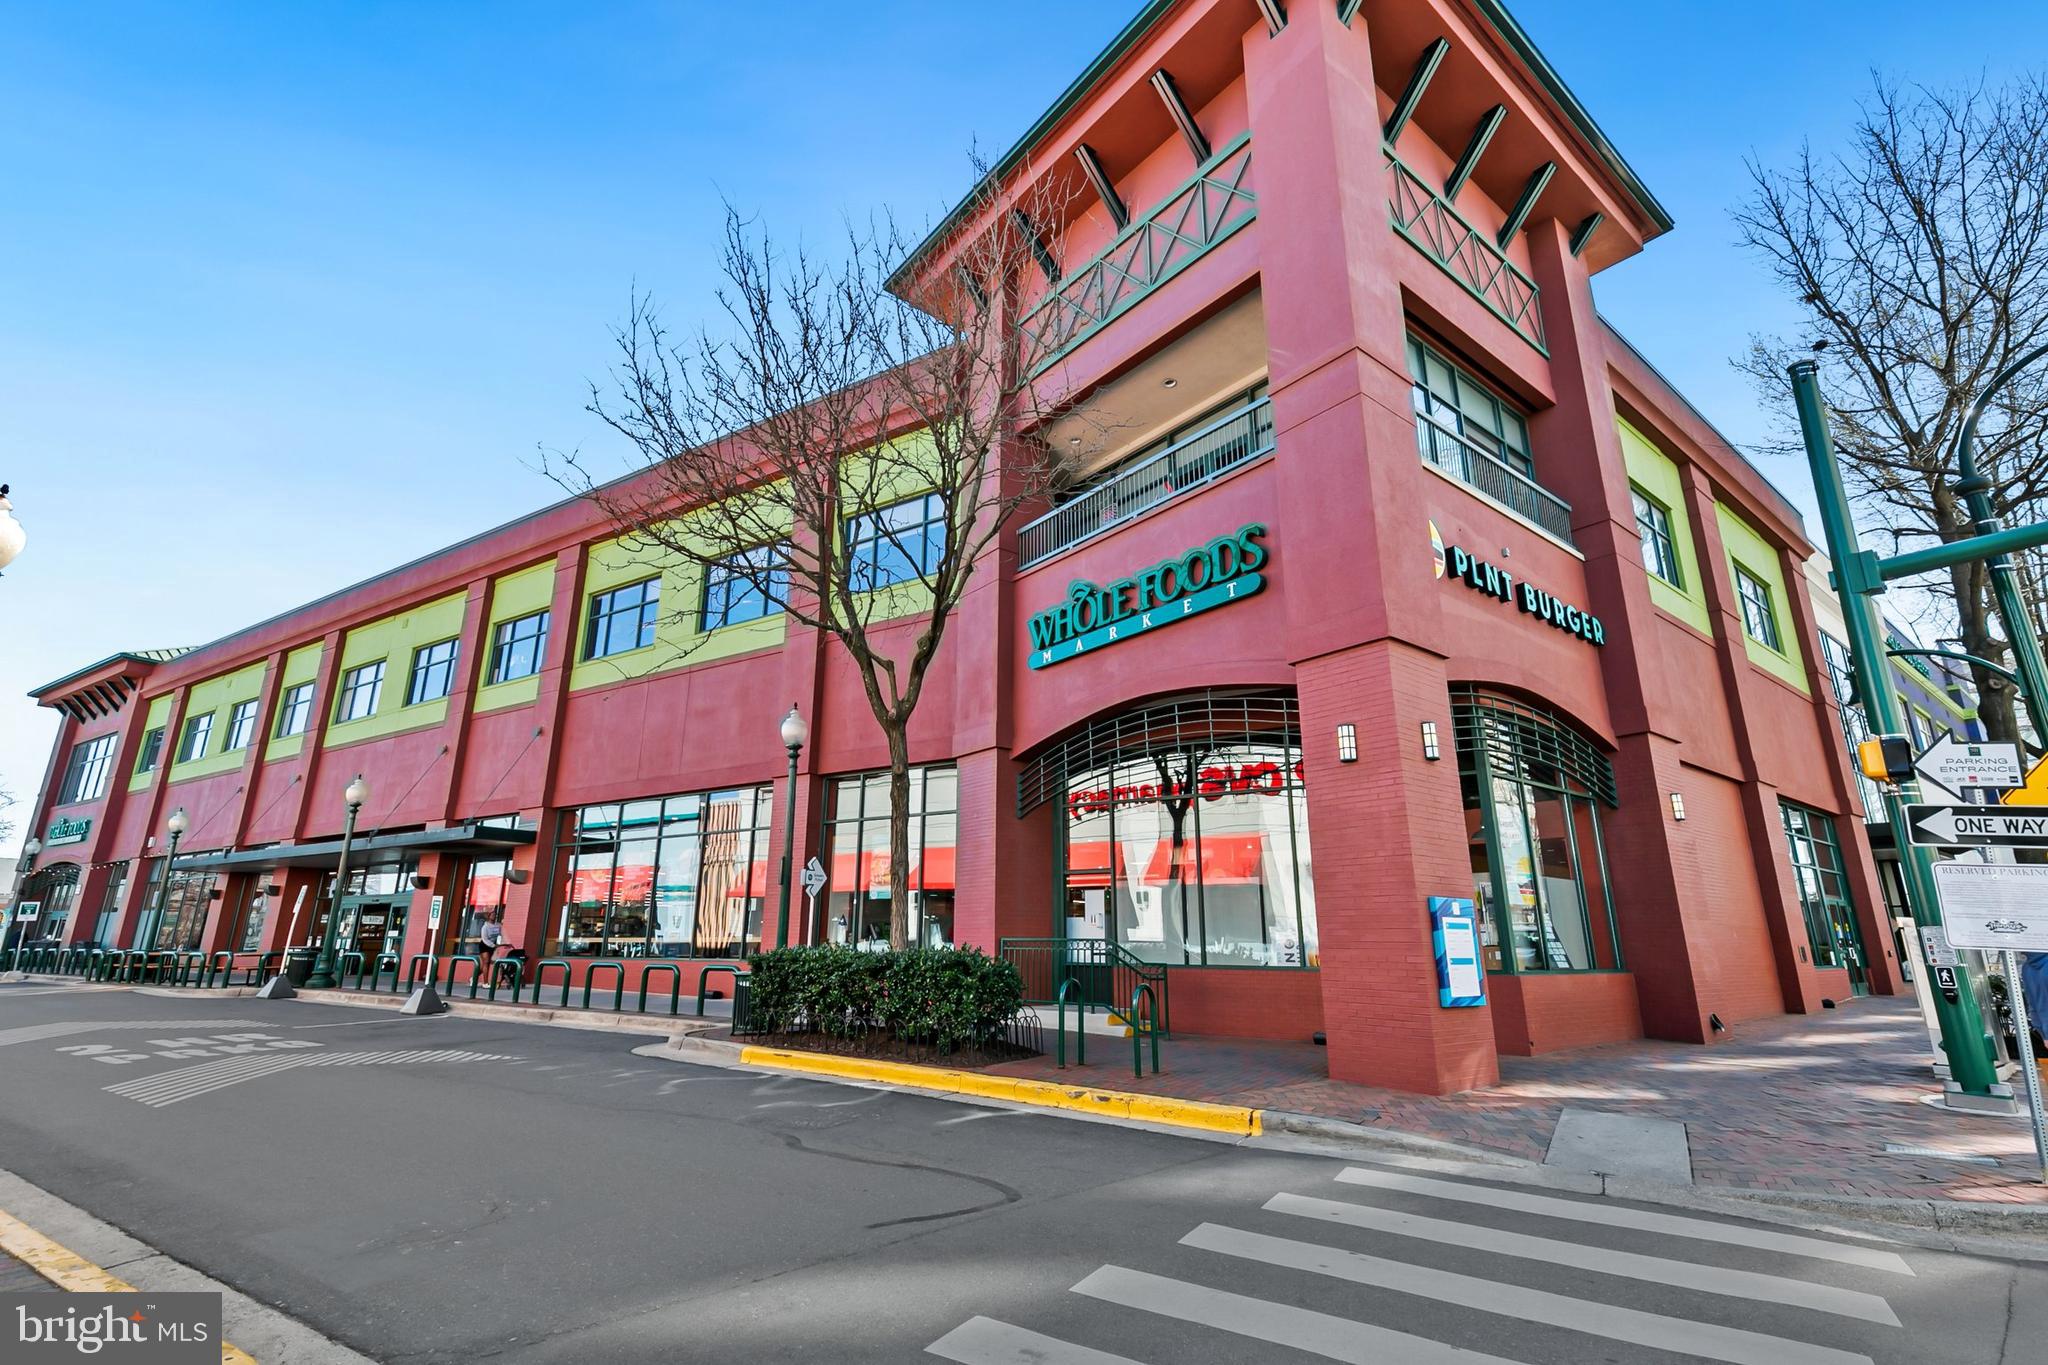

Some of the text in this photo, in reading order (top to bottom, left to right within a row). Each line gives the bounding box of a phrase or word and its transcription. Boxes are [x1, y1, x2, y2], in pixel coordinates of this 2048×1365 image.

[1027, 523, 1268, 650] WHOLE FOODS
[1447, 545, 1605, 647] PLNT BURGER
[1042, 581, 1237, 663] MARKET
[1939, 765, 2017, 773] ENTRANCE
[1945, 757, 2008, 765] PARKING
[1954, 817, 2046, 835] ONE WAY
[1941, 866, 1996, 875] RESERVED
[54, 1033, 284, 1056] 2 HR
[89, 1040, 326, 1065] PRKG
